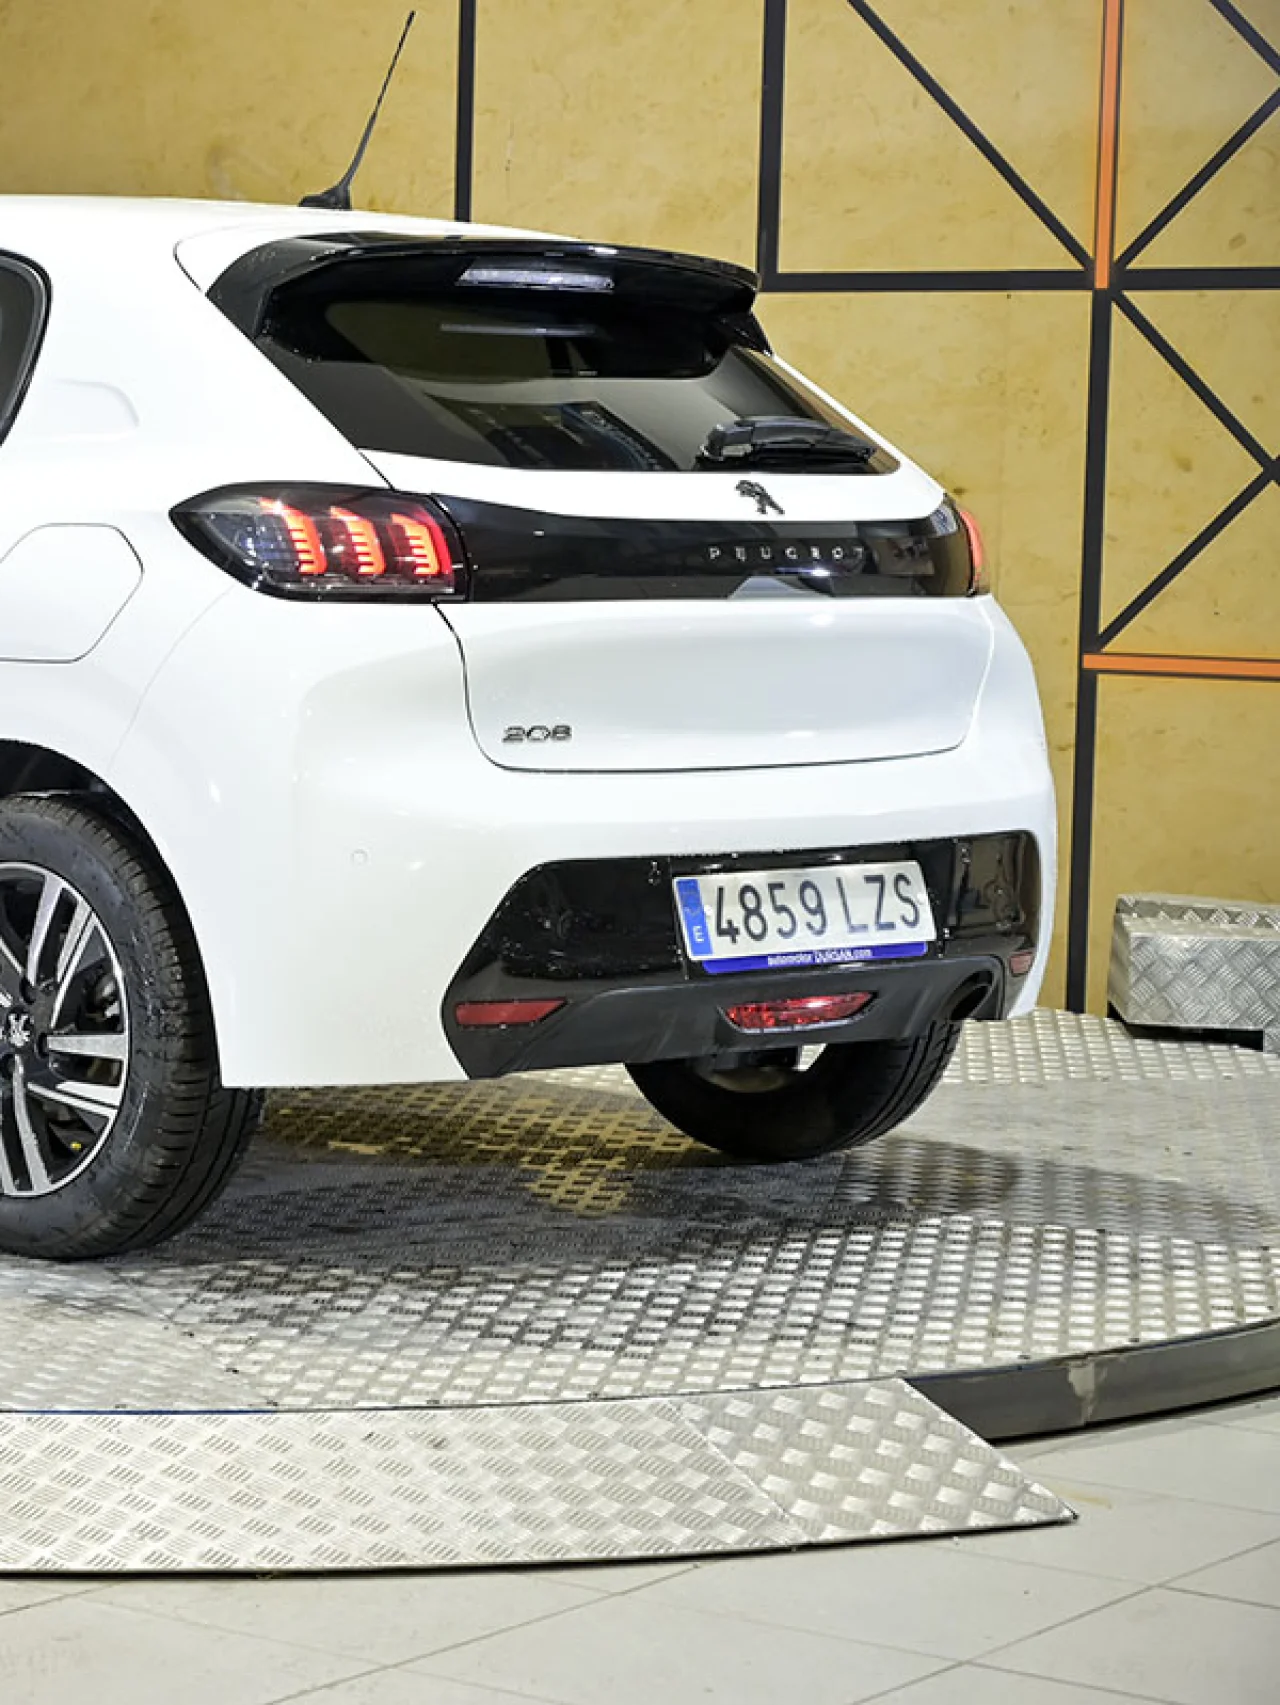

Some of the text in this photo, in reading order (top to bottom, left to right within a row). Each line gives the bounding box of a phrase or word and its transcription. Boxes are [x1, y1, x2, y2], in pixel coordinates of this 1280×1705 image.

[502, 725, 571, 742] 208
[716, 872, 920, 943] 4859 LZS
[693, 925, 704, 942] E
